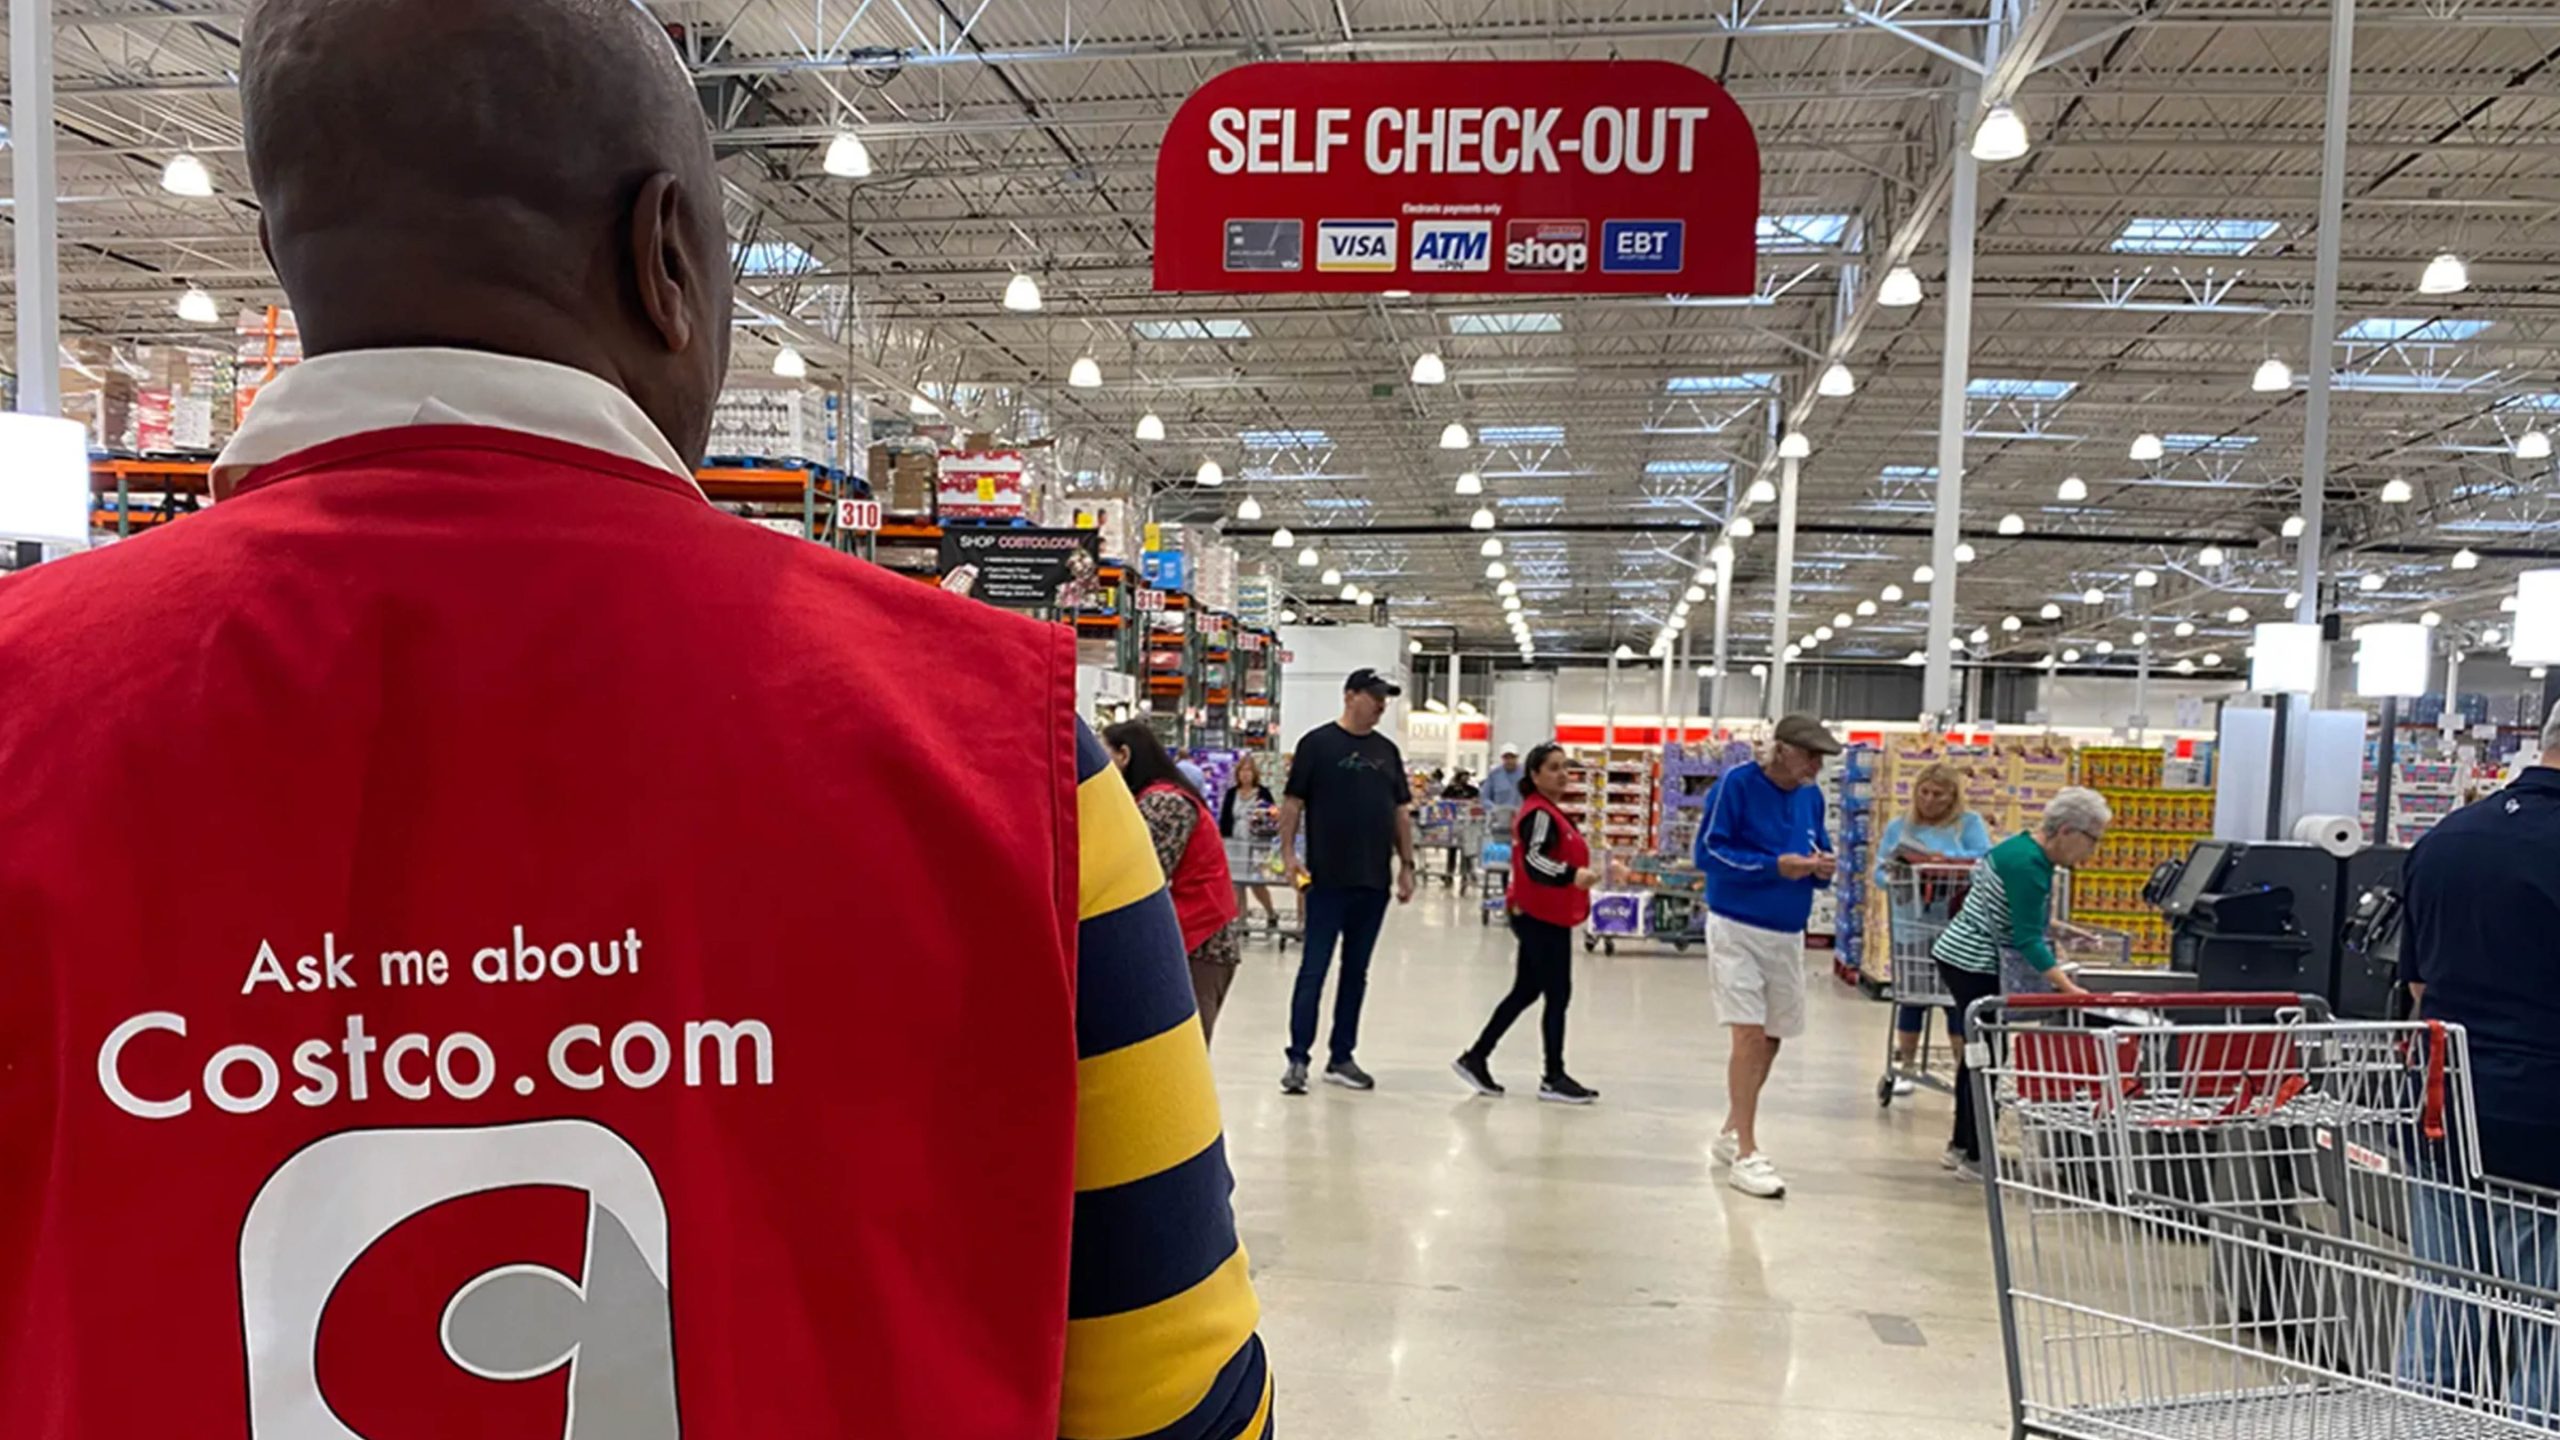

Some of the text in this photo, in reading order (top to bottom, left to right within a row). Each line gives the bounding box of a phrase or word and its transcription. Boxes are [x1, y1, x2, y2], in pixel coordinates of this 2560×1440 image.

[1208, 106, 1710, 175] SELF CHECK-OUT
[1443, 203, 1482, 216] payments
[1484, 203, 1502, 216] only
[1328, 235, 1387, 257] VISA
[1414, 232, 1488, 260] ATM
[1506, 237, 1587, 272] shop
[1617, 232, 1668, 254] EBT
[842, 502, 878, 528] 310
[960, 535, 1079, 549] SHOP COSTCO.COM
[1137, 591, 1163, 608] 314
[241, 924, 643, 995] Ask me about
[97, 1010, 774, 1119] Costco.com
